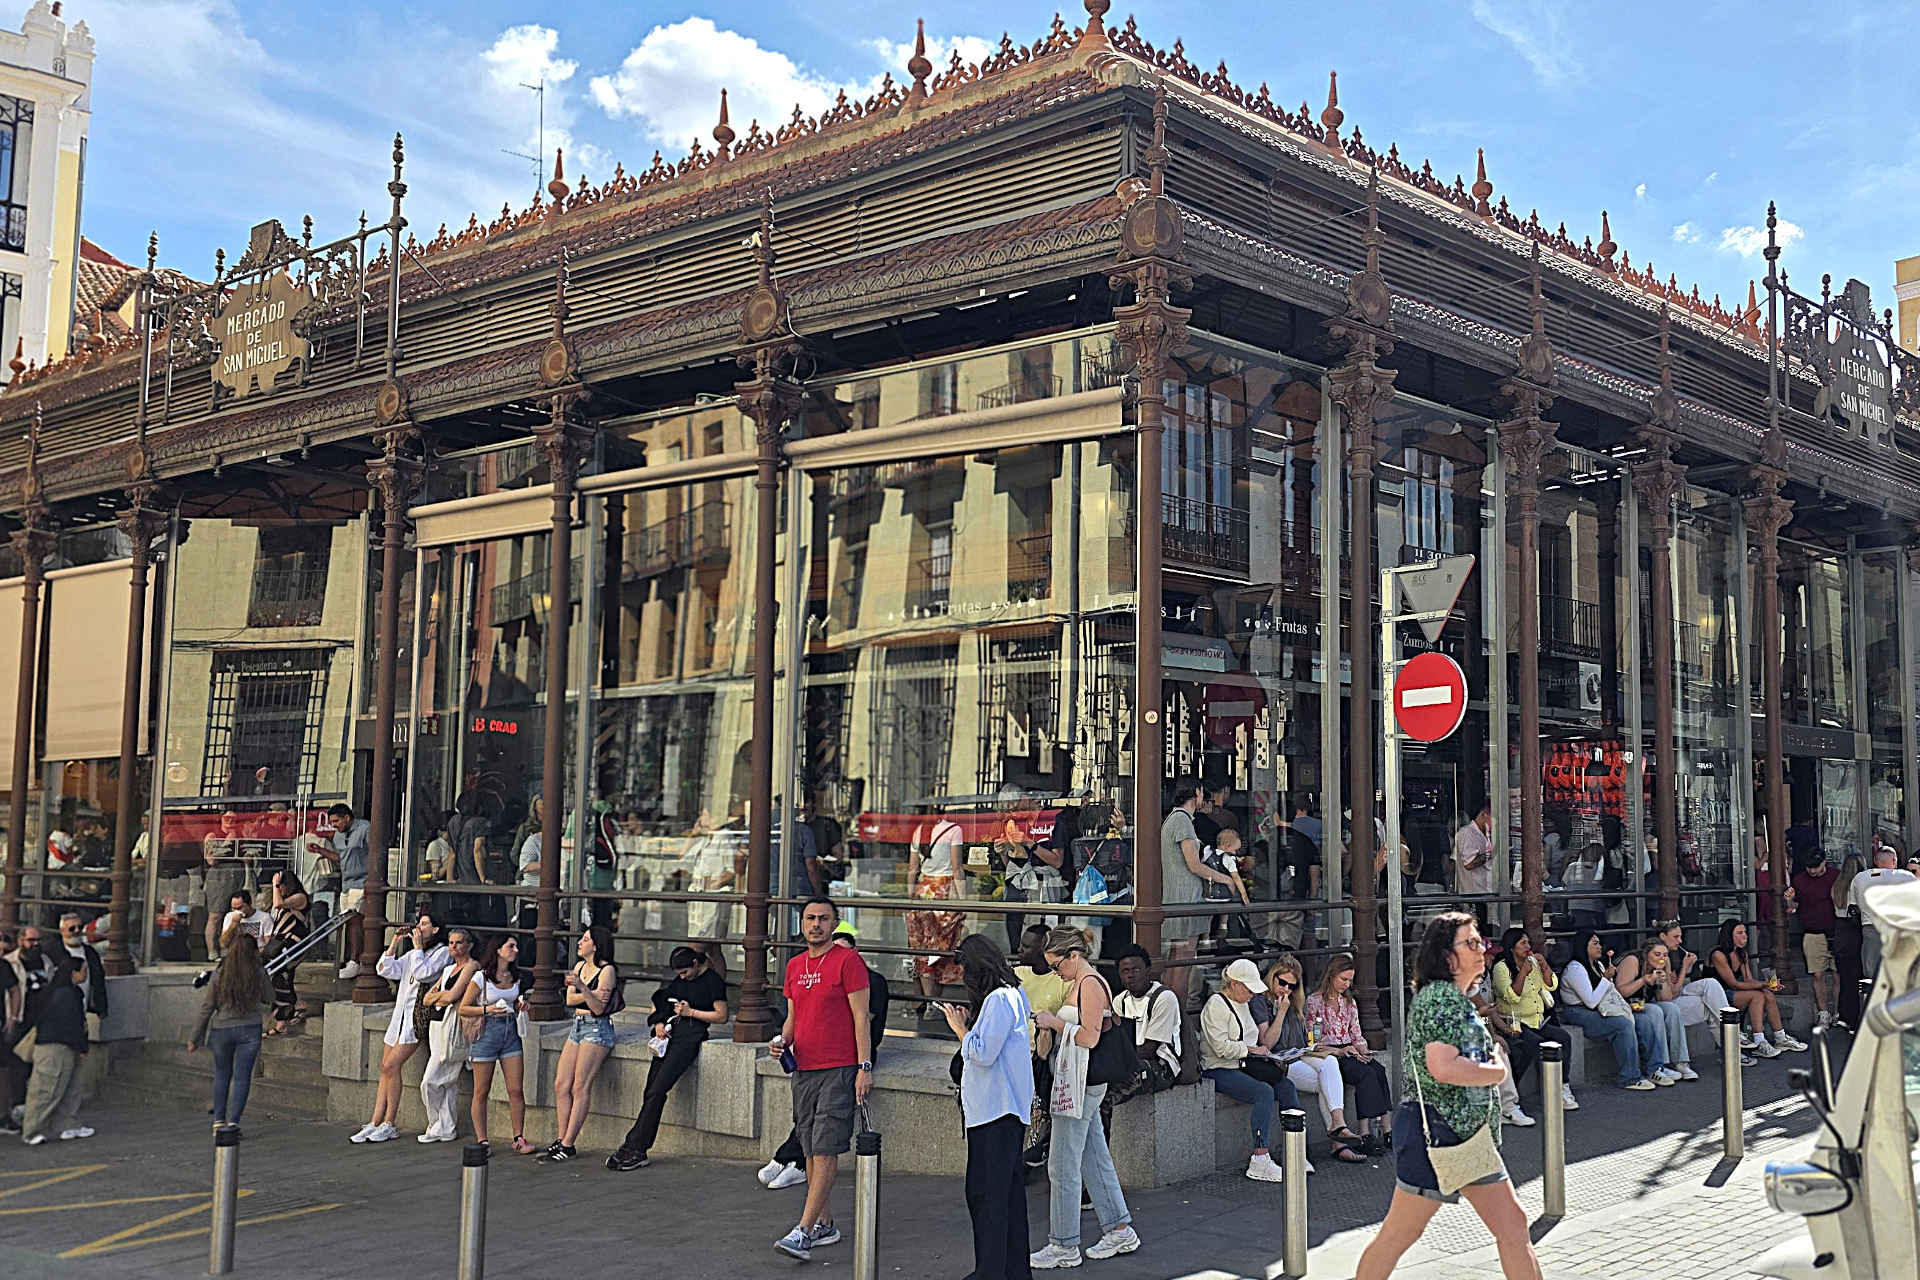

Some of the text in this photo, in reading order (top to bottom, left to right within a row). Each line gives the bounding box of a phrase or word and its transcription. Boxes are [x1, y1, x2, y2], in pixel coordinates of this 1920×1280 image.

[226, 300, 285, 336] MERCADO
[246, 329, 263, 346] DE
[223, 351, 243, 375] SAN
[1840, 355, 1885, 389] MERCADO
[1857, 383, 1870, 398] DE
[1840, 391, 1858, 413] SAN
[1275, 616, 1308, 635] Frutas
[1402, 632, 1433, 650] Zumos
[489, 719, 518, 735] CRAB
